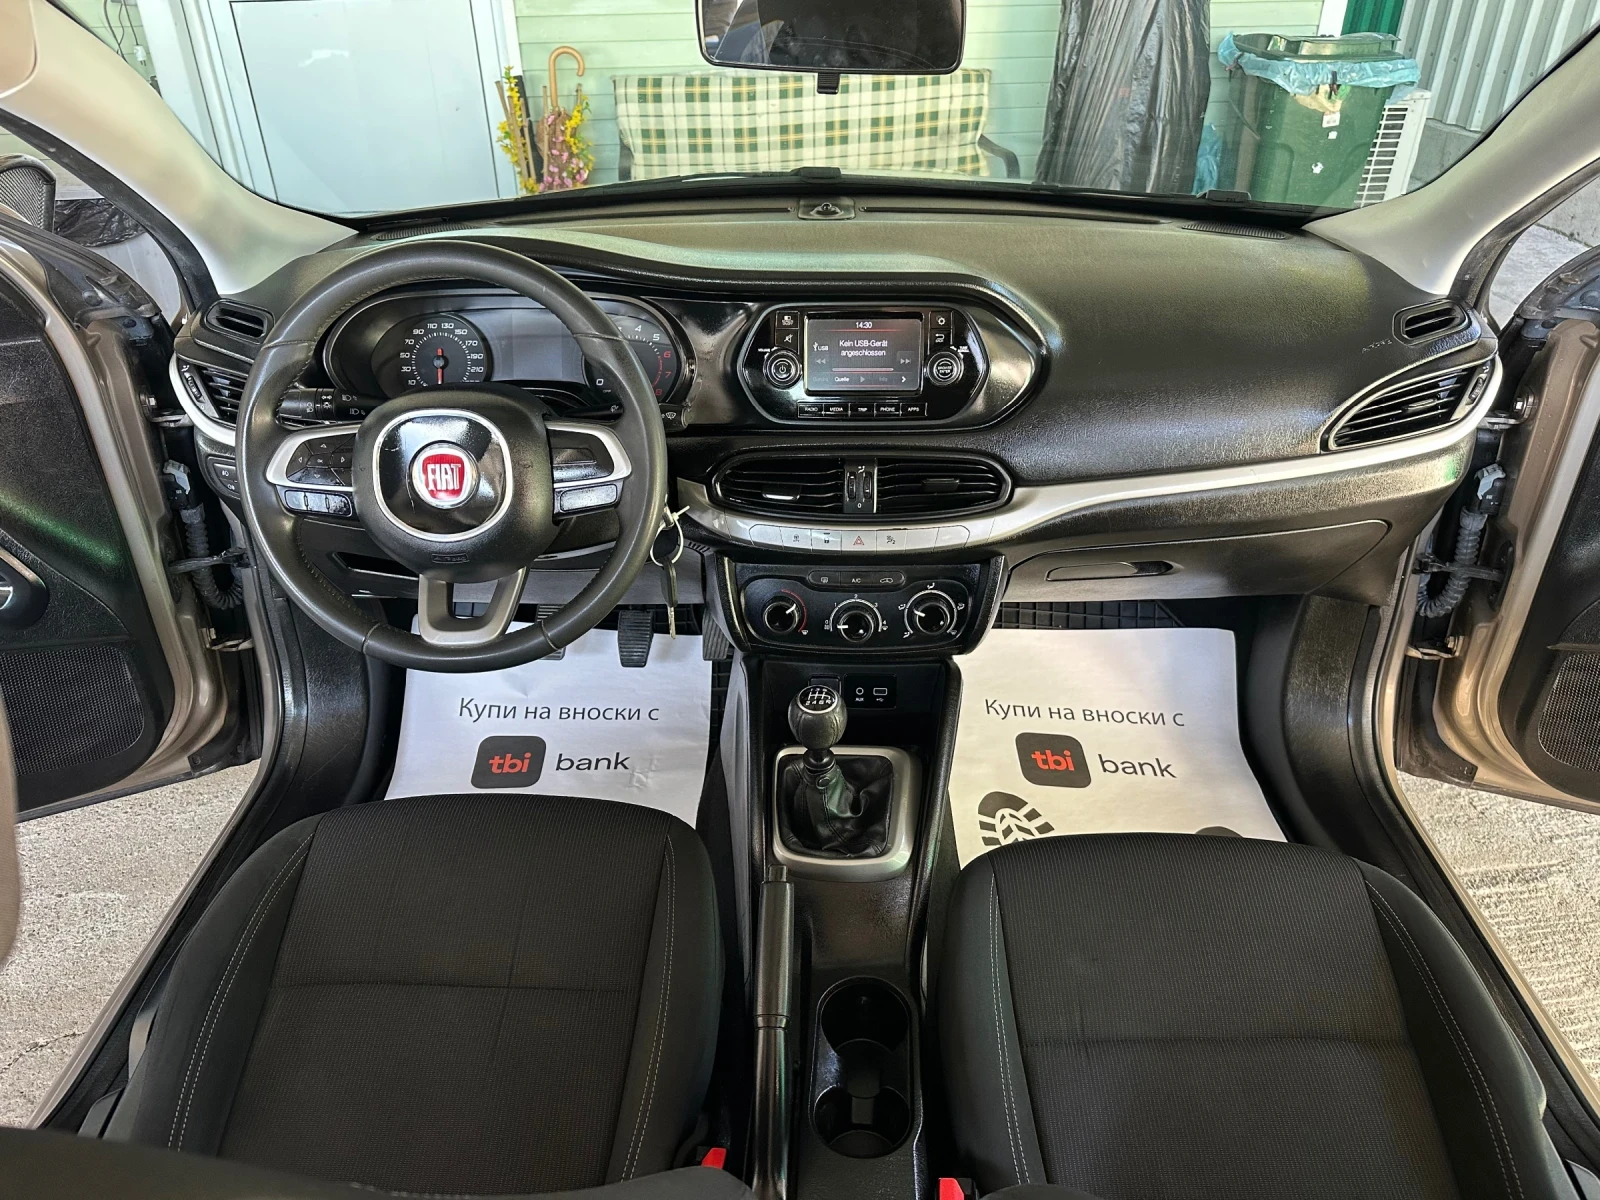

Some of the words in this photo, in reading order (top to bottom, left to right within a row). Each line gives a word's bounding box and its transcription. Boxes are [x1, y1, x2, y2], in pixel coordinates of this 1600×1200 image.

[634, 324, 642, 332] 4
[652, 333, 660, 341] 5
[855, 321, 873, 329] 14:30
[427, 463, 461, 490] FIAT
[458, 697, 517, 723] Купи
[524, 705, 551, 720] на
[558, 706, 641, 721] вноски
[648, 708, 660, 721] с
[984, 698, 1041, 720] Купи
[1048, 706, 1075, 721] на
[1083, 708, 1166, 726] вноски
[1172, 712, 1185, 727] с
[488, 752, 532, 774] tbi
[555, 752, 631, 772] bank
[1031, 749, 1075, 772] tbi
[1097, 753, 1177, 778] bank
